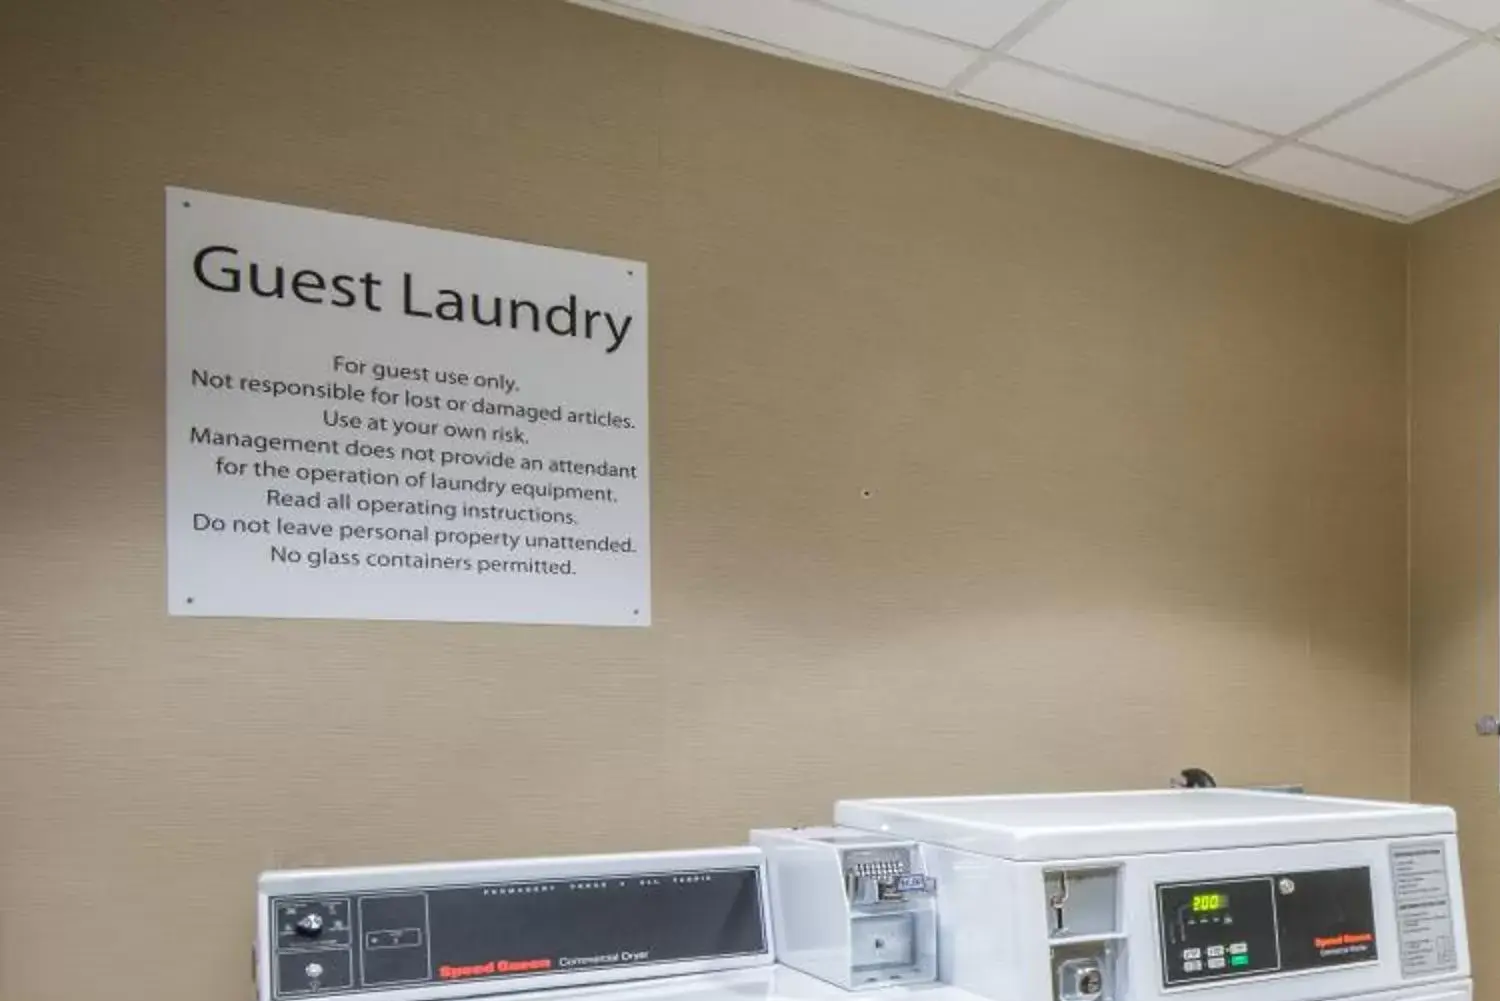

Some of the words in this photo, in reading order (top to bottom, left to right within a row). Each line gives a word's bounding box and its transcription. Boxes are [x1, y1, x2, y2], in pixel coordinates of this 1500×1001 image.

[193, 246, 382, 312] Guest
[404, 273, 633, 354] Laundry
[334, 355, 367, 375] For
[372, 364, 430, 385] guest
[435, 371, 468, 385] use
[474, 374, 519, 395] only.
[192, 369, 233, 389] Not
[240, 378, 365, 402] responsible
[371, 386, 400, 405] for
[405, 389, 441, 409] lost
[446, 400, 469, 412] or
[472, 398, 562, 425] damaged
[567, 410, 635, 430] articles.
[323, 410, 362, 429] Use
[367, 417, 388, 431] at
[392, 419, 438, 439] your
[444, 425, 486, 440] own
[492, 426, 528, 444] risk.
[190, 427, 339, 458] Management
[345, 440, 395, 459] does
[401, 446, 435, 463] not
[441, 449, 515, 473] provide
[520, 458, 543, 471] an
[548, 459, 637, 479] attendant
[216, 456, 248, 475] for
[253, 460, 290, 478] the
[296, 467, 399, 491] operation
[405, 471, 427, 488] of
[431, 472, 506, 498] laundry
[511, 483, 617, 504] equipment.
[267, 489, 320, 508] Read
[327, 493, 350, 510] all
[357, 497, 457, 521] operating
[463, 502, 576, 525] instructions.
[193, 513, 226, 531] Do
[233, 519, 270, 534] not
[277, 517, 333, 537] leave
[340, 523, 429, 543] personal
[434, 530, 520, 552] property
[525, 534, 636, 554] unattended.
[271, 546, 302, 563] No
[307, 548, 360, 568] glass
[366, 552, 472, 570] containers
[477, 557, 576, 575] permitted.
